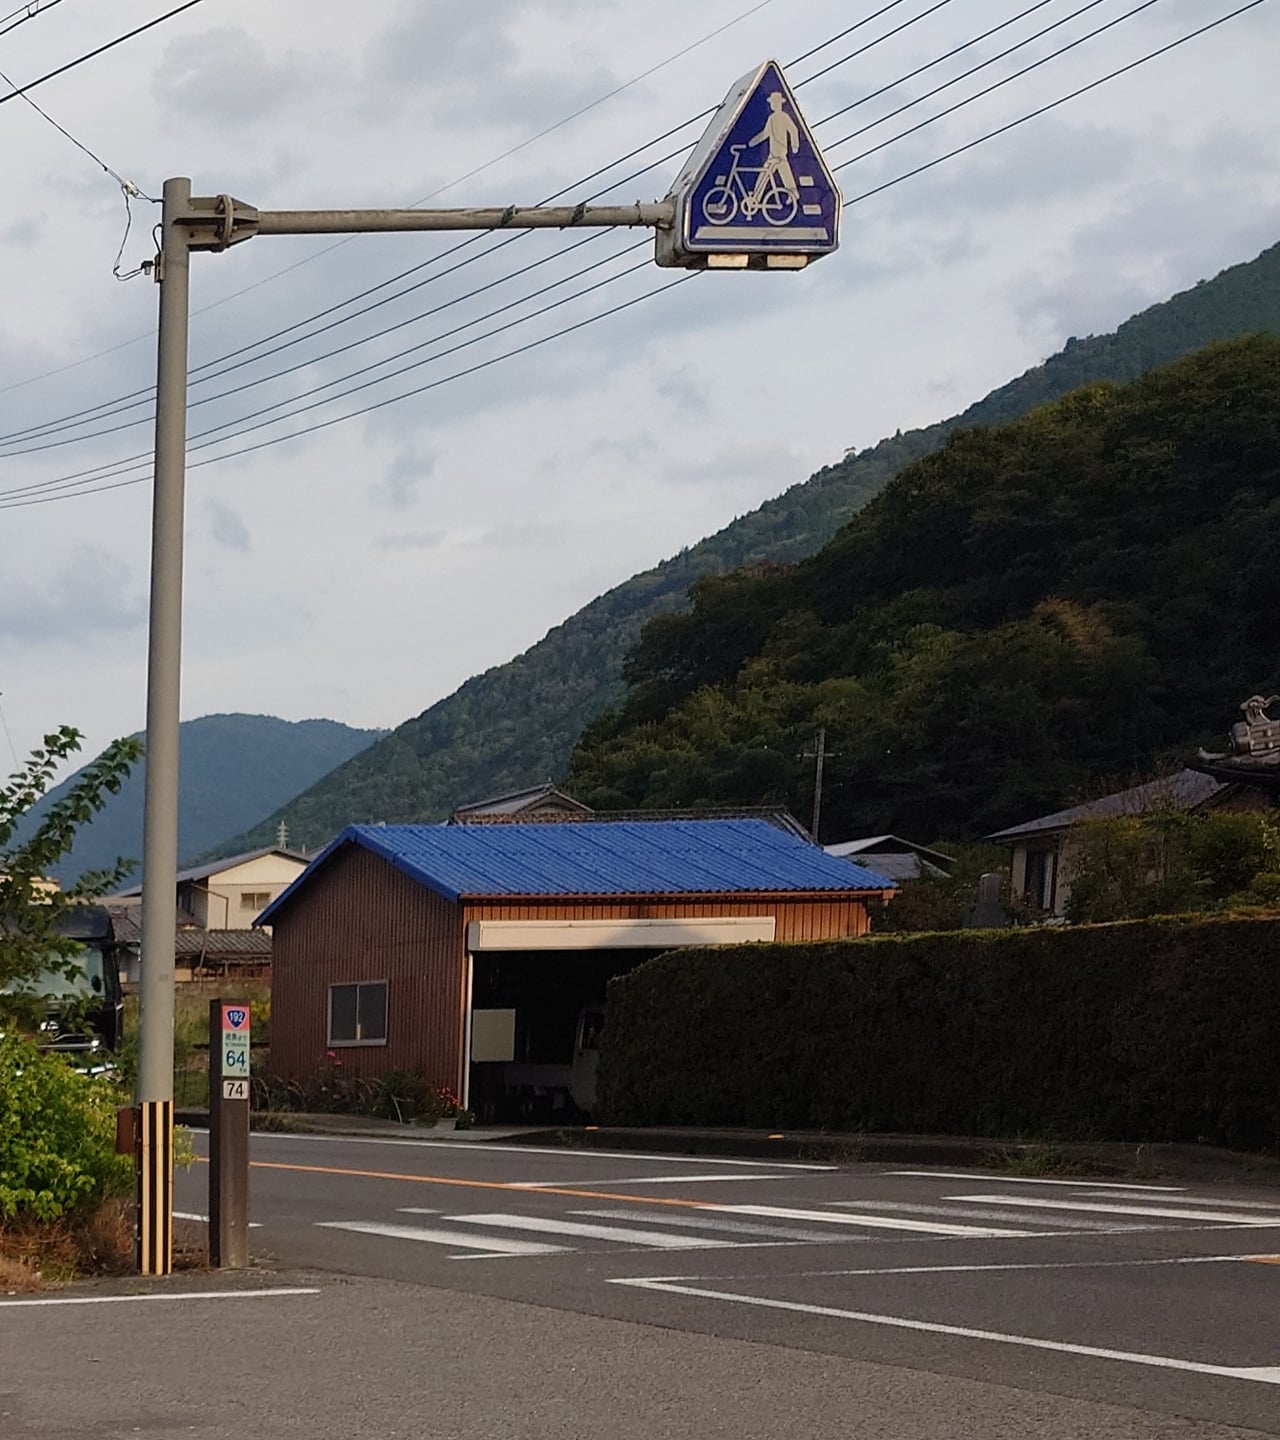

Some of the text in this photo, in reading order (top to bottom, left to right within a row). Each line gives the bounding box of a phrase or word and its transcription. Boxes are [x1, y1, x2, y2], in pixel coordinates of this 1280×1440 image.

[229, 1011, 244, 1022] 192
[226, 1050, 246, 1067] 64
[226, 1082, 244, 1097] 74
